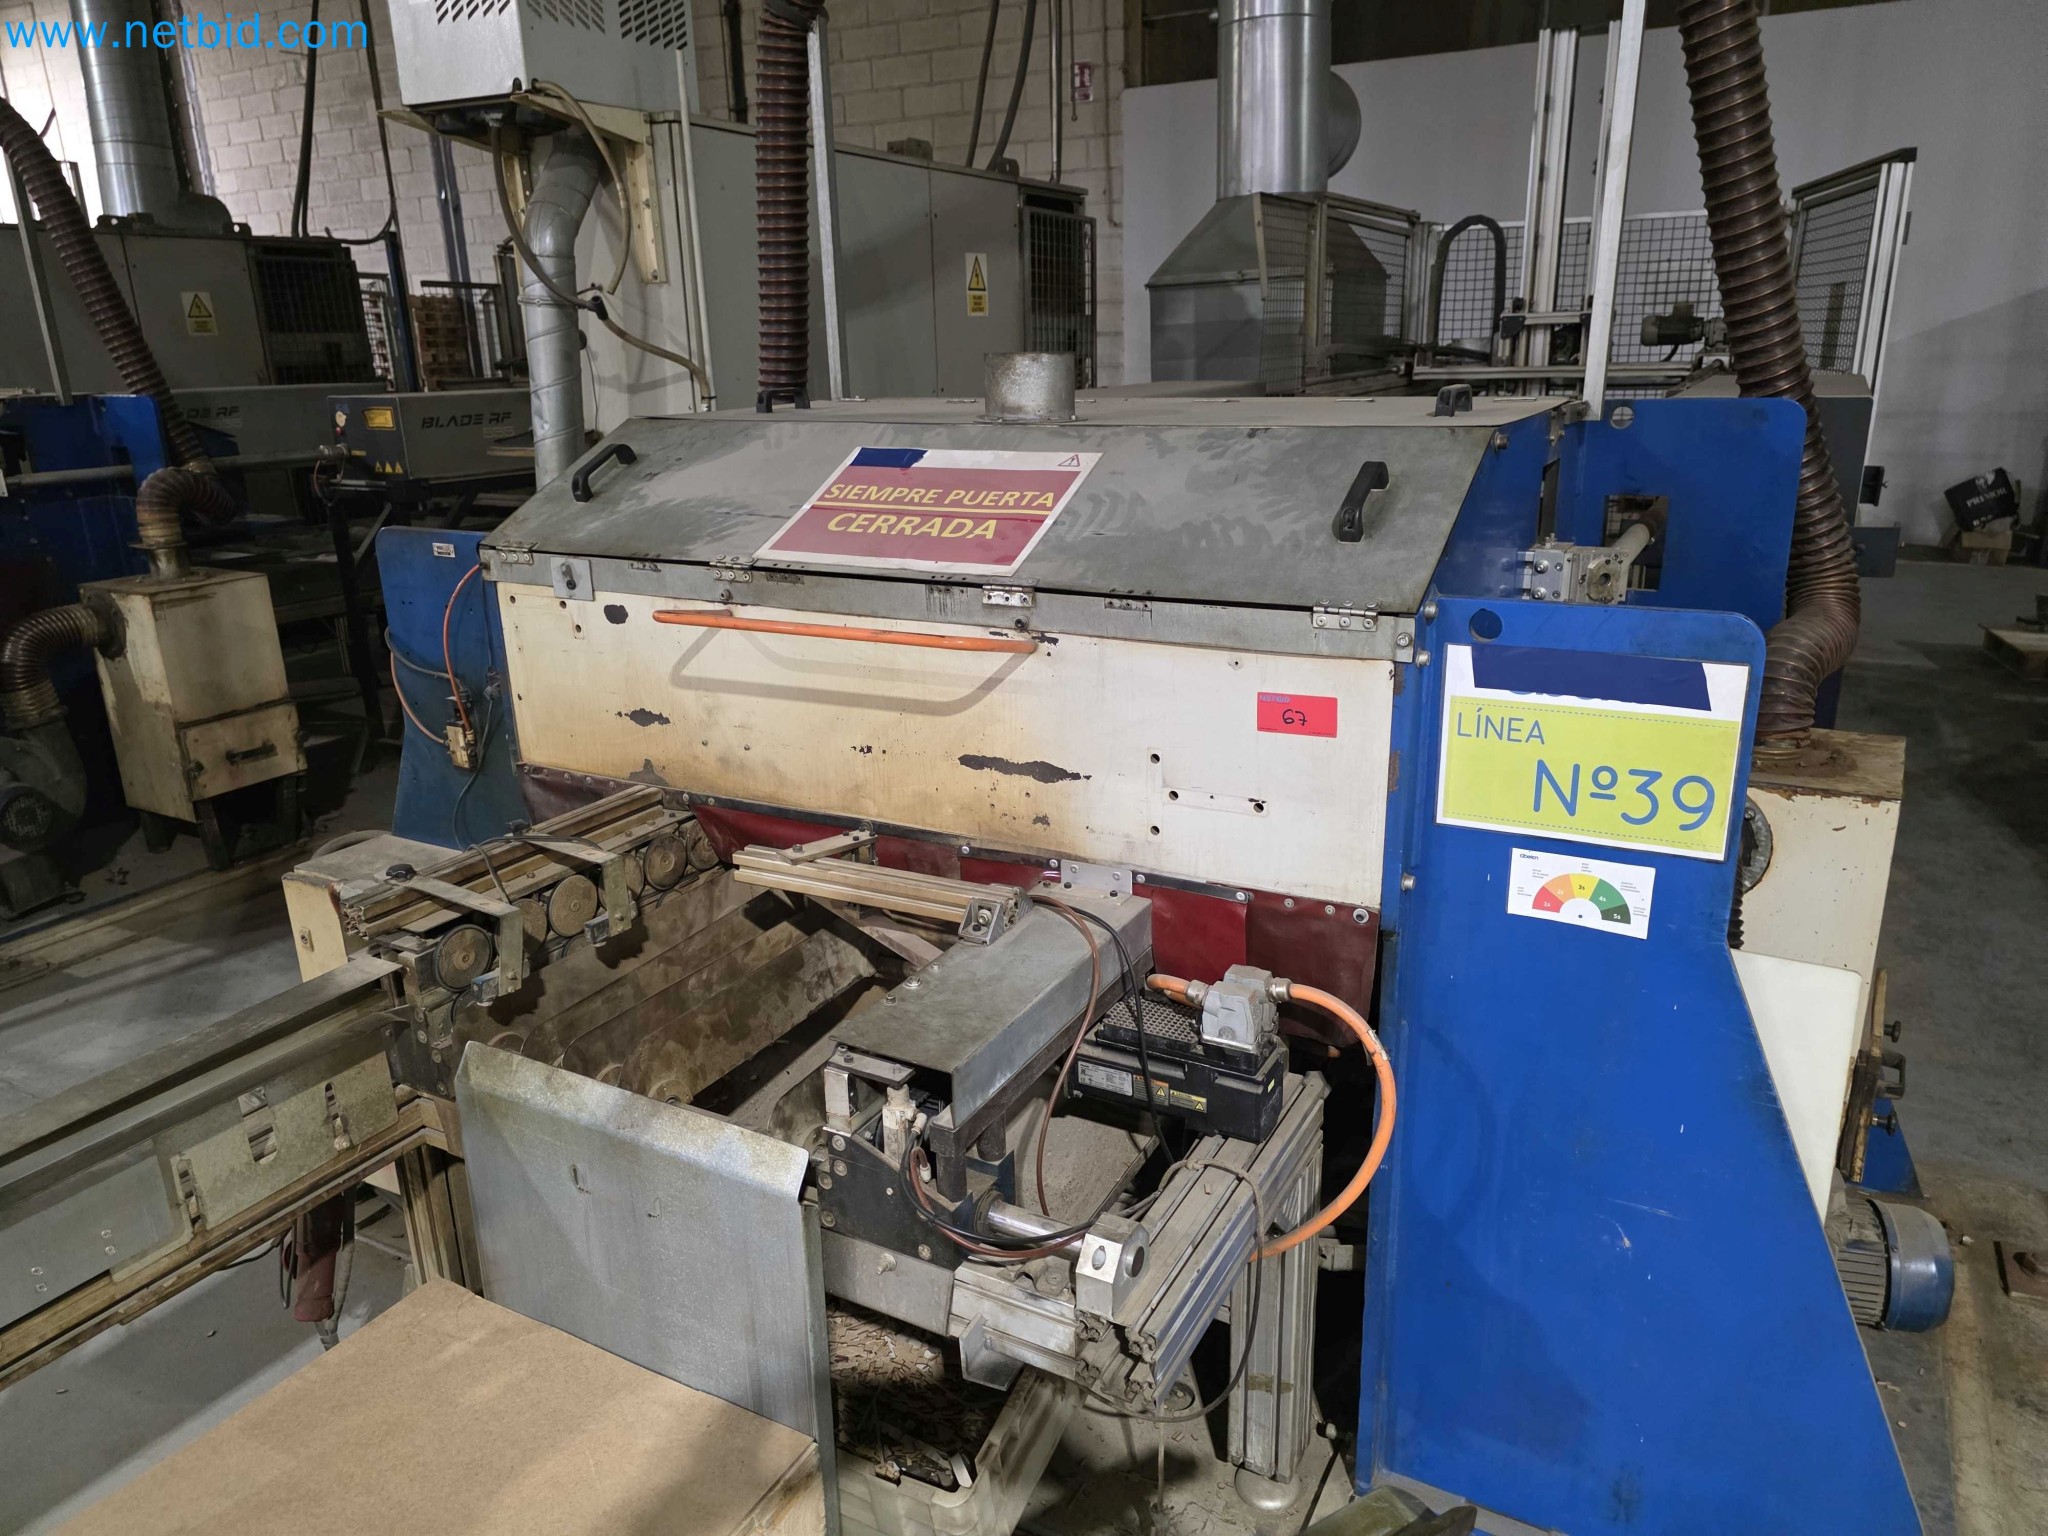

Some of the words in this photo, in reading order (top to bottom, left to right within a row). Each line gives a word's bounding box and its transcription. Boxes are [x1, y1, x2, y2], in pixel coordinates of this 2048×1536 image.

[421, 412, 484, 430] BLADE
[489, 411, 513, 425] RF
[824, 483, 943, 504] SIEMPRE
[943, 490, 1055, 507] PUERTA
[827, 512, 997, 540] CERRADA
[1282, 708, 1308, 727] 67
[1457, 707, 1545, 745] LÍNEA
